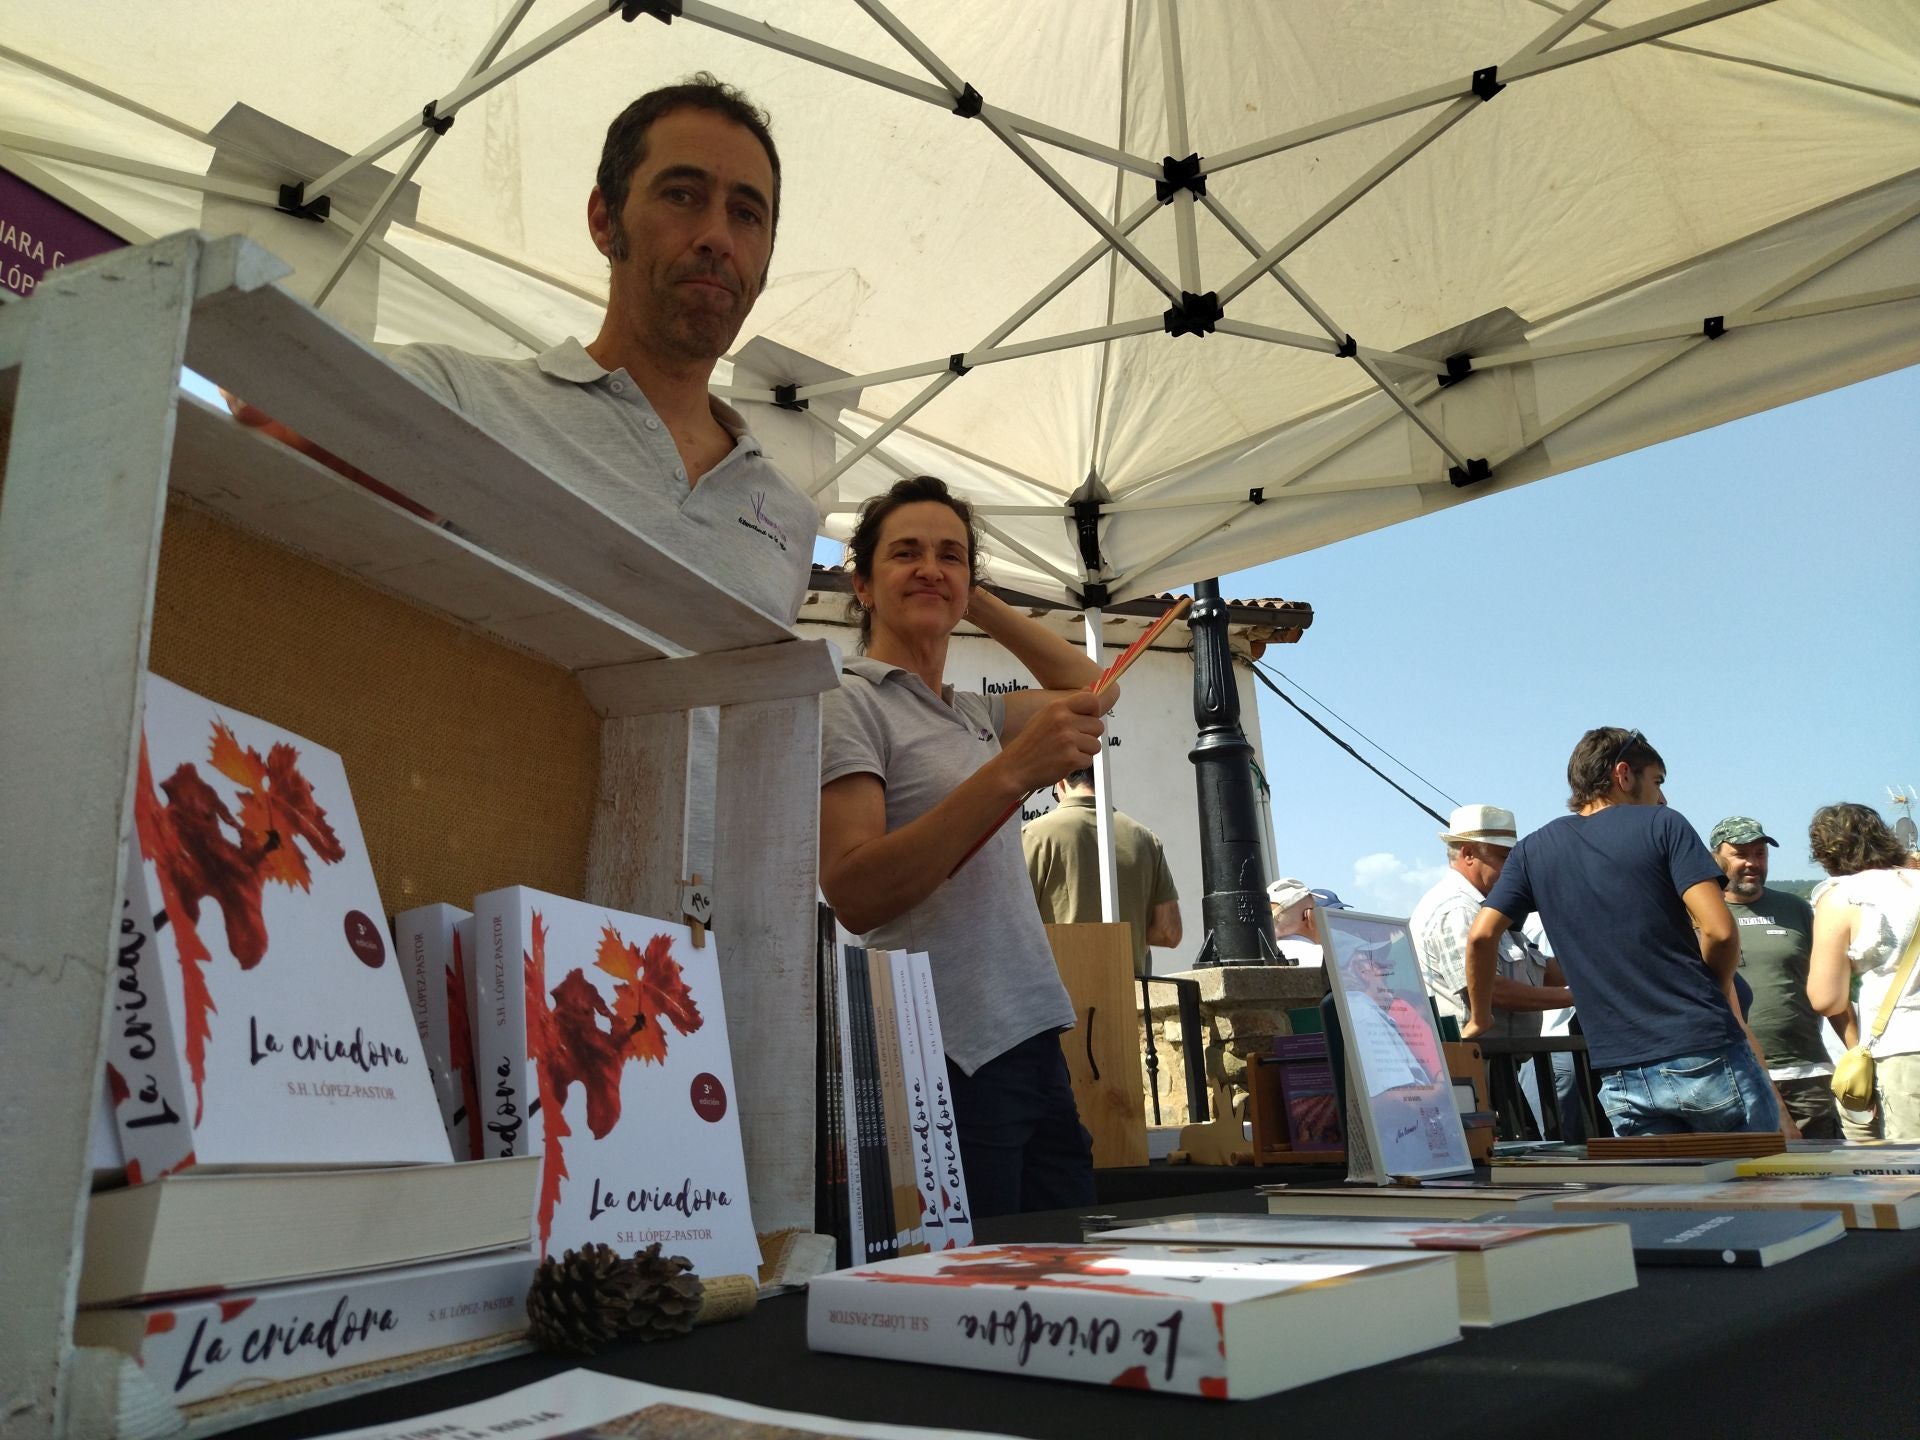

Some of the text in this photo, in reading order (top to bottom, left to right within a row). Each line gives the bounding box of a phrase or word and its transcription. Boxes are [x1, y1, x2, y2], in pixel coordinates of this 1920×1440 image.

[0, 220, 45, 264] ARA
[0, 260, 42, 293] LÓP
[493, 915, 505, 1001] LÓPEZ-PASTOR
[250, 1015, 409, 1072] La criadora
[126, 1074, 180, 1129] La
[313, 1080, 397, 1100] LÓPEZ-PASTOR
[487, 1055, 522, 1158] adora
[913, 1077, 943, 1228] La criadora
[936, 1077, 969, 1224] La criadora
[589, 1177, 732, 1221] La criadora
[617, 1228, 713, 1243] S.H. LÓPEZ-PASTOR
[174, 1295, 399, 1392] La criadora
[828, 1309, 905, 1333] LÓPEZ-PASTOR
[958, 1300, 1183, 1382] La criadora
